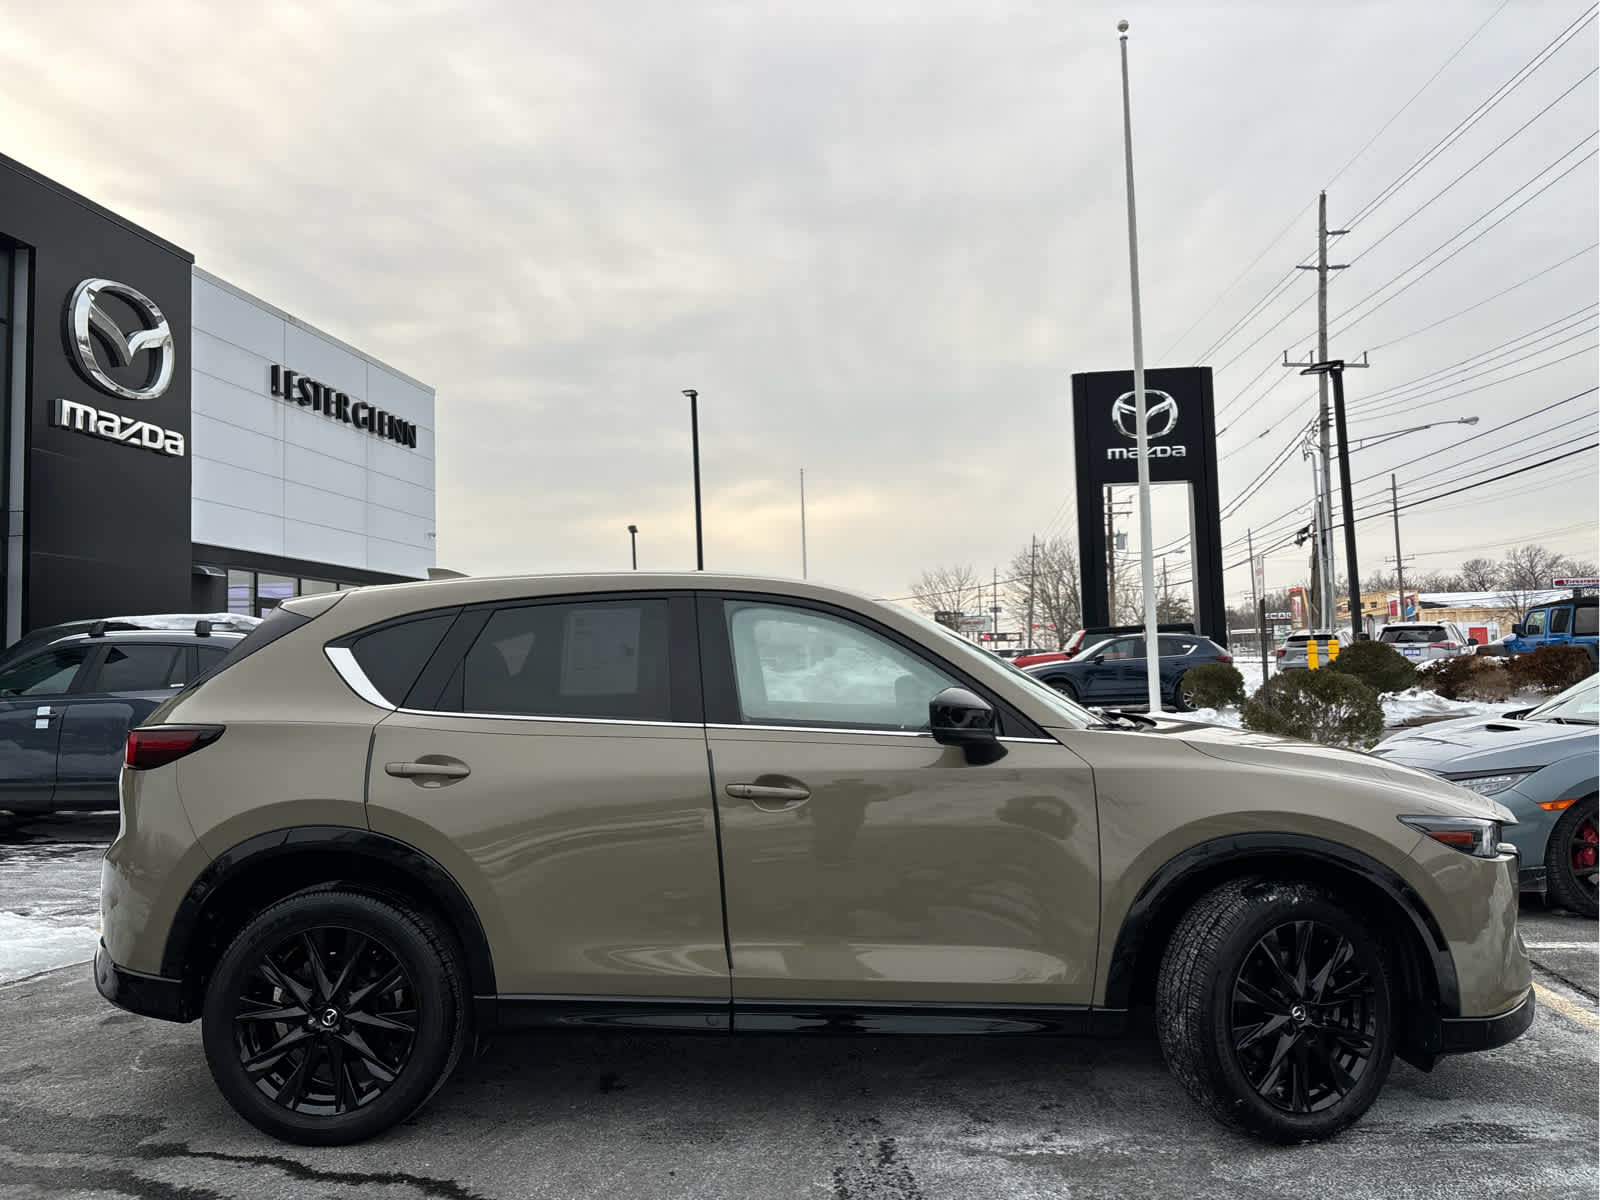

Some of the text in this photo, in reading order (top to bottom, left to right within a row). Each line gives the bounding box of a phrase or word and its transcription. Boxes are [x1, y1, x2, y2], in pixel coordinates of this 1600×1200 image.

[57, 399, 184, 456] mazda
[271, 365, 416, 449] LESTER GLENN
